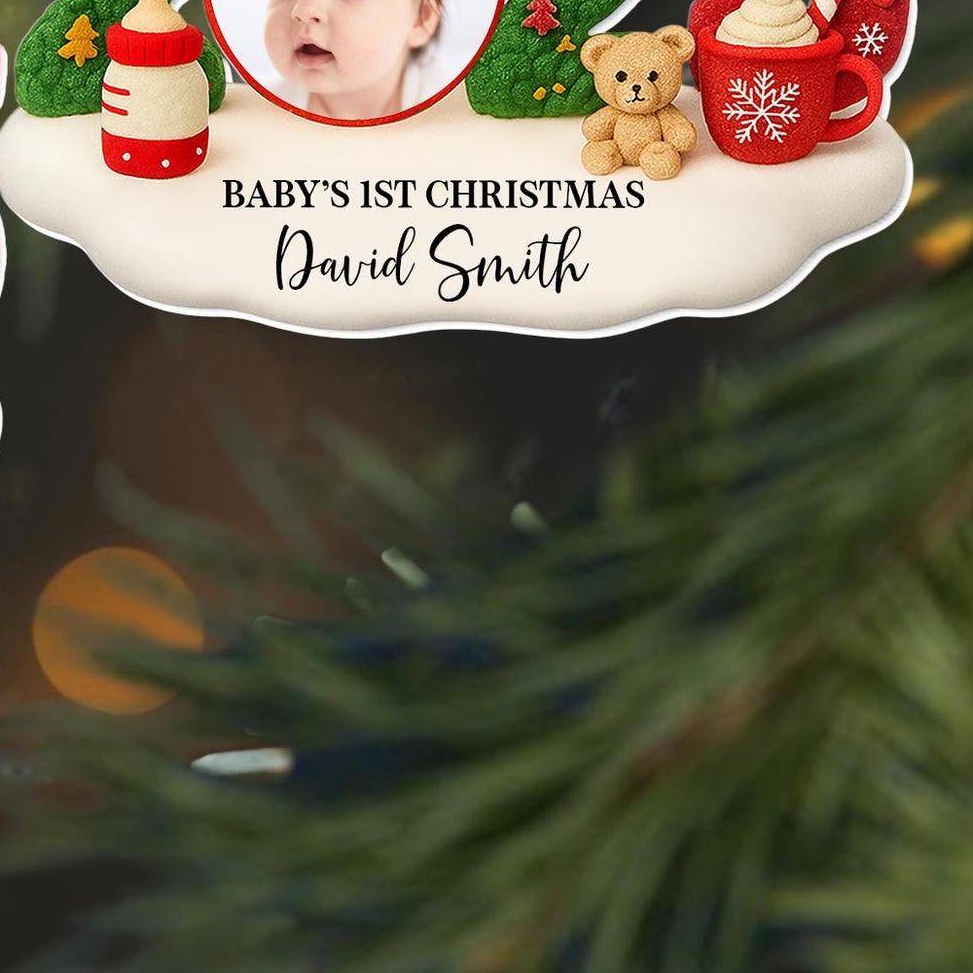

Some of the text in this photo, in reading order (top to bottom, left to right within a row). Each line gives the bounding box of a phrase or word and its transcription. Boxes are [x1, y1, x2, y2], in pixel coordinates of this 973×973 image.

[222, 179, 645, 209] BABY’S 1ST CHRISTMAS
[275, 223, 590, 303] David Smith
